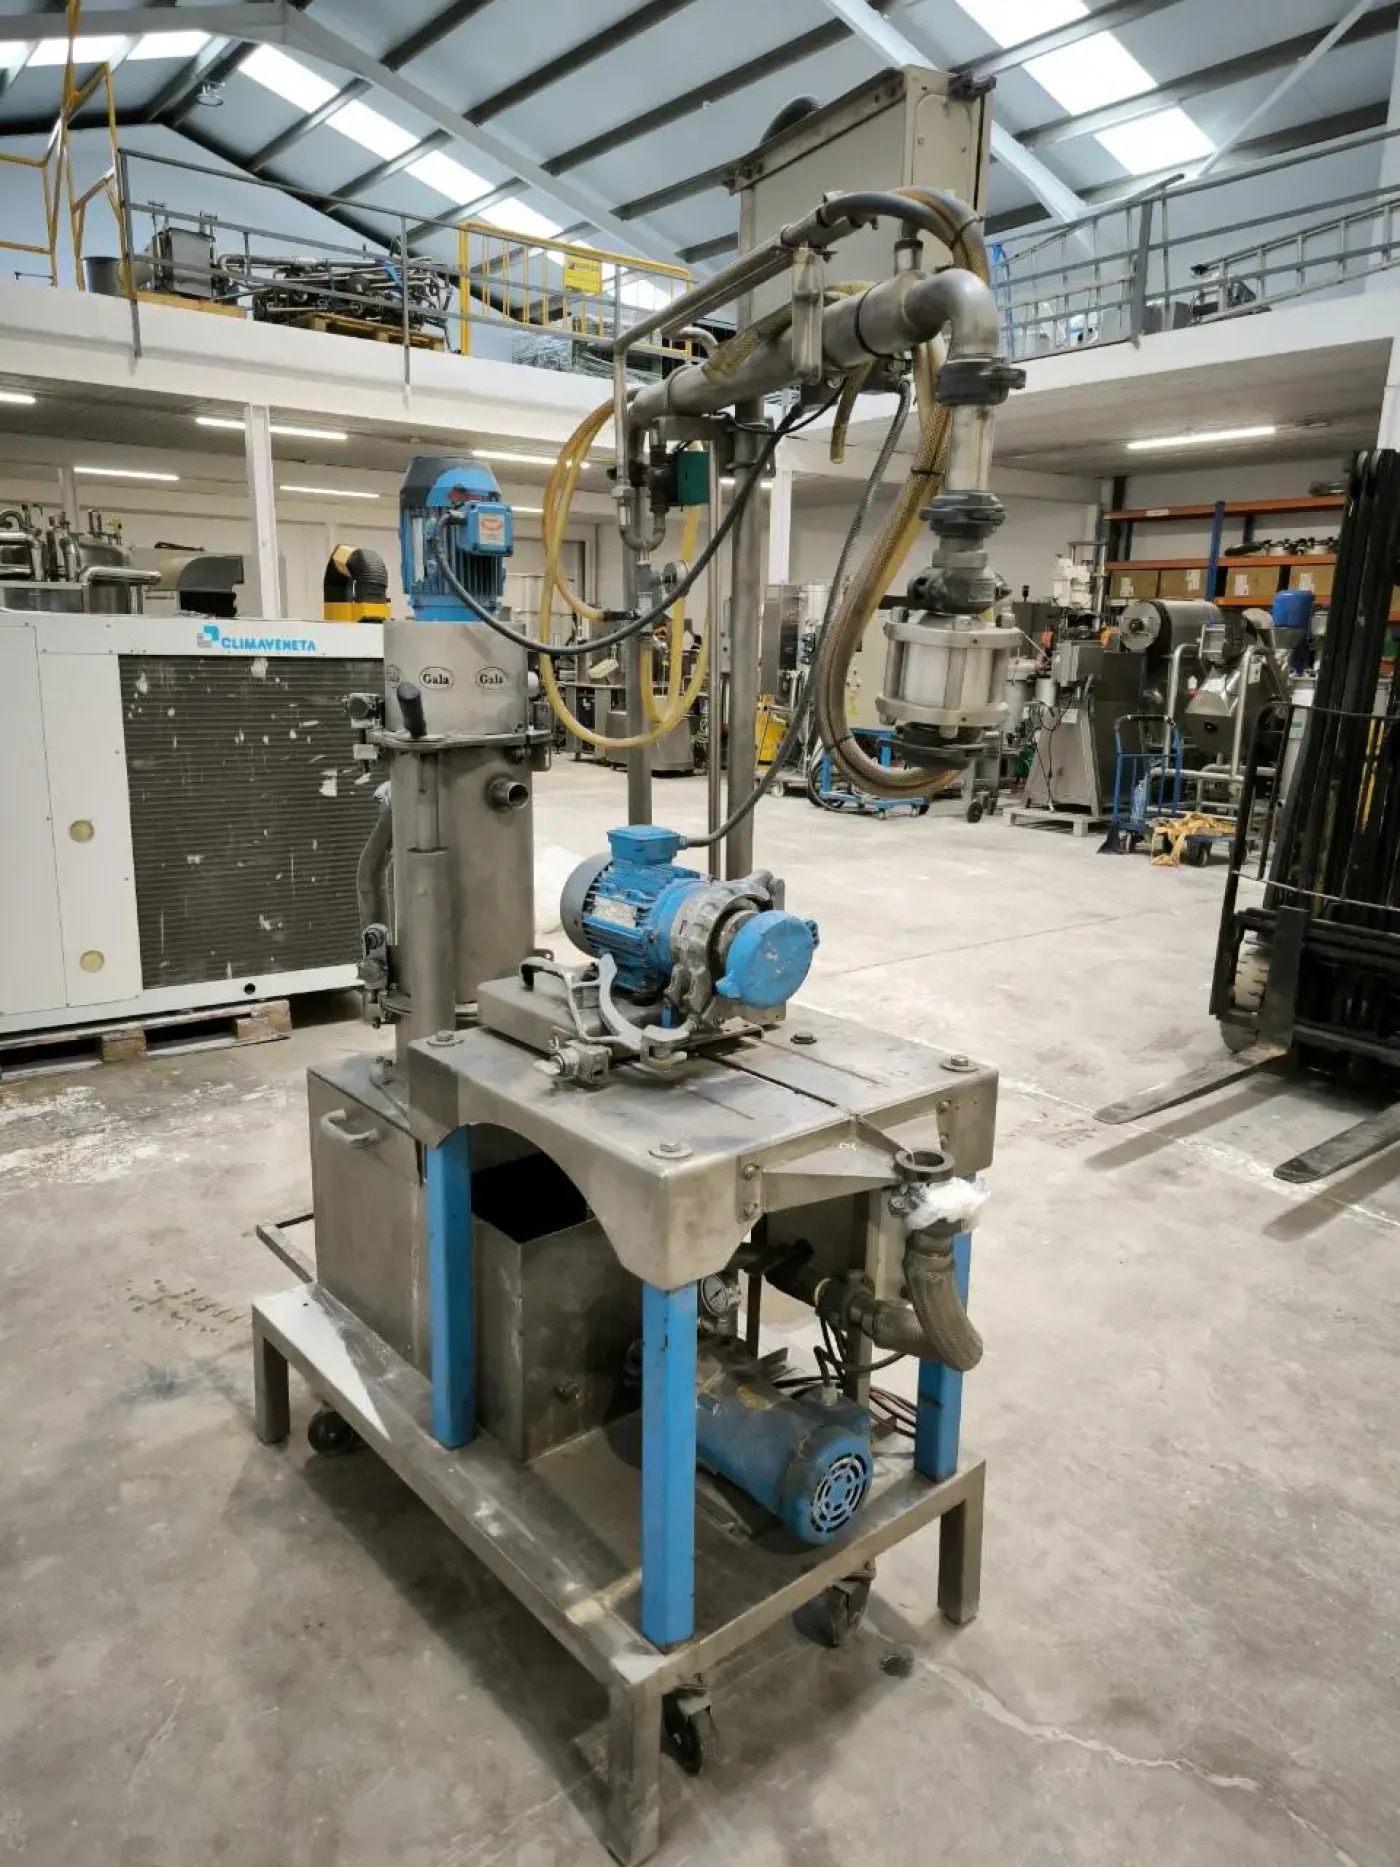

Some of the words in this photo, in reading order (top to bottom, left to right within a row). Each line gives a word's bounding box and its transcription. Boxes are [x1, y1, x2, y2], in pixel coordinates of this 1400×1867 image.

[221, 637, 316, 651] CLIMAVENETA
[422, 673, 450, 685] Gala
[479, 673, 504, 685] Gala
